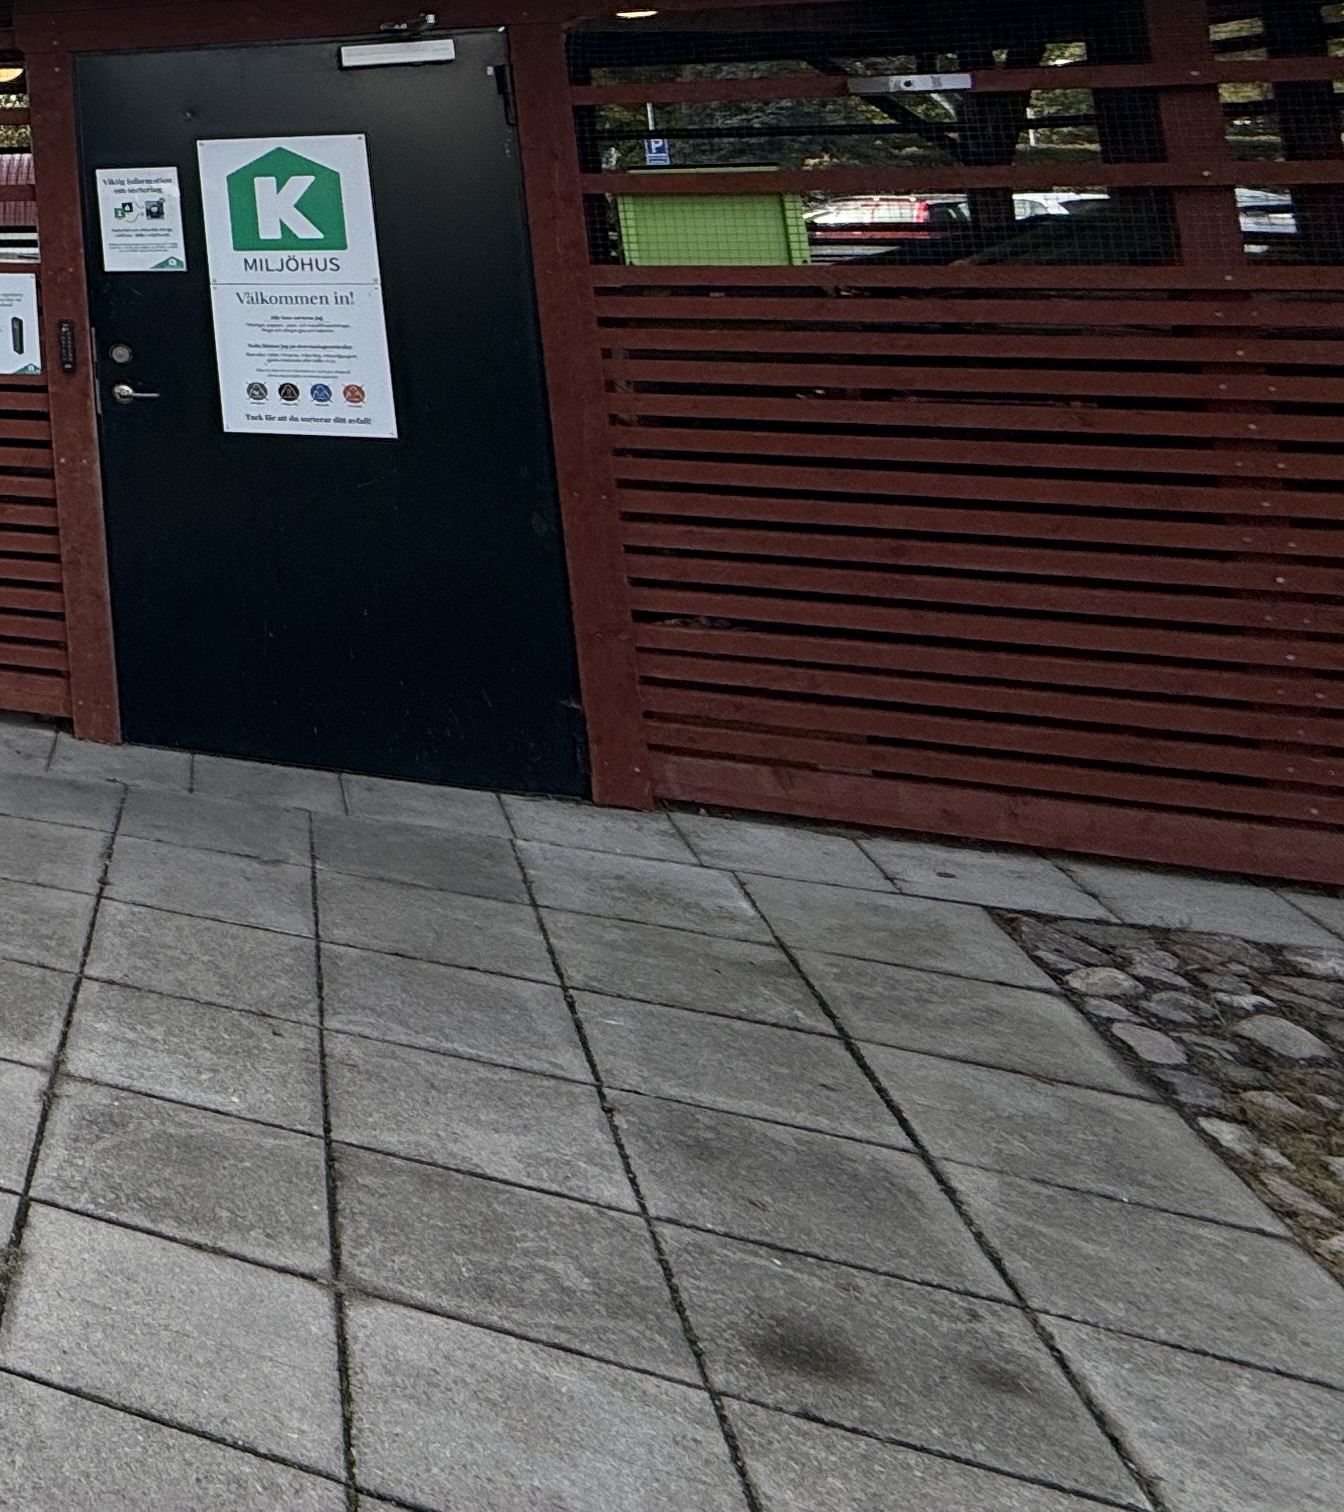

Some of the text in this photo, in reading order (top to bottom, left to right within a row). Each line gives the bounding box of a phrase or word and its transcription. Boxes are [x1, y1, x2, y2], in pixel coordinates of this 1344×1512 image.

[651, 139, 663, 153] P
[254, 176, 324, 239] K
[244, 255, 340, 272] MILJÖHUS
[235, 291, 355, 306] Välkommen in!
